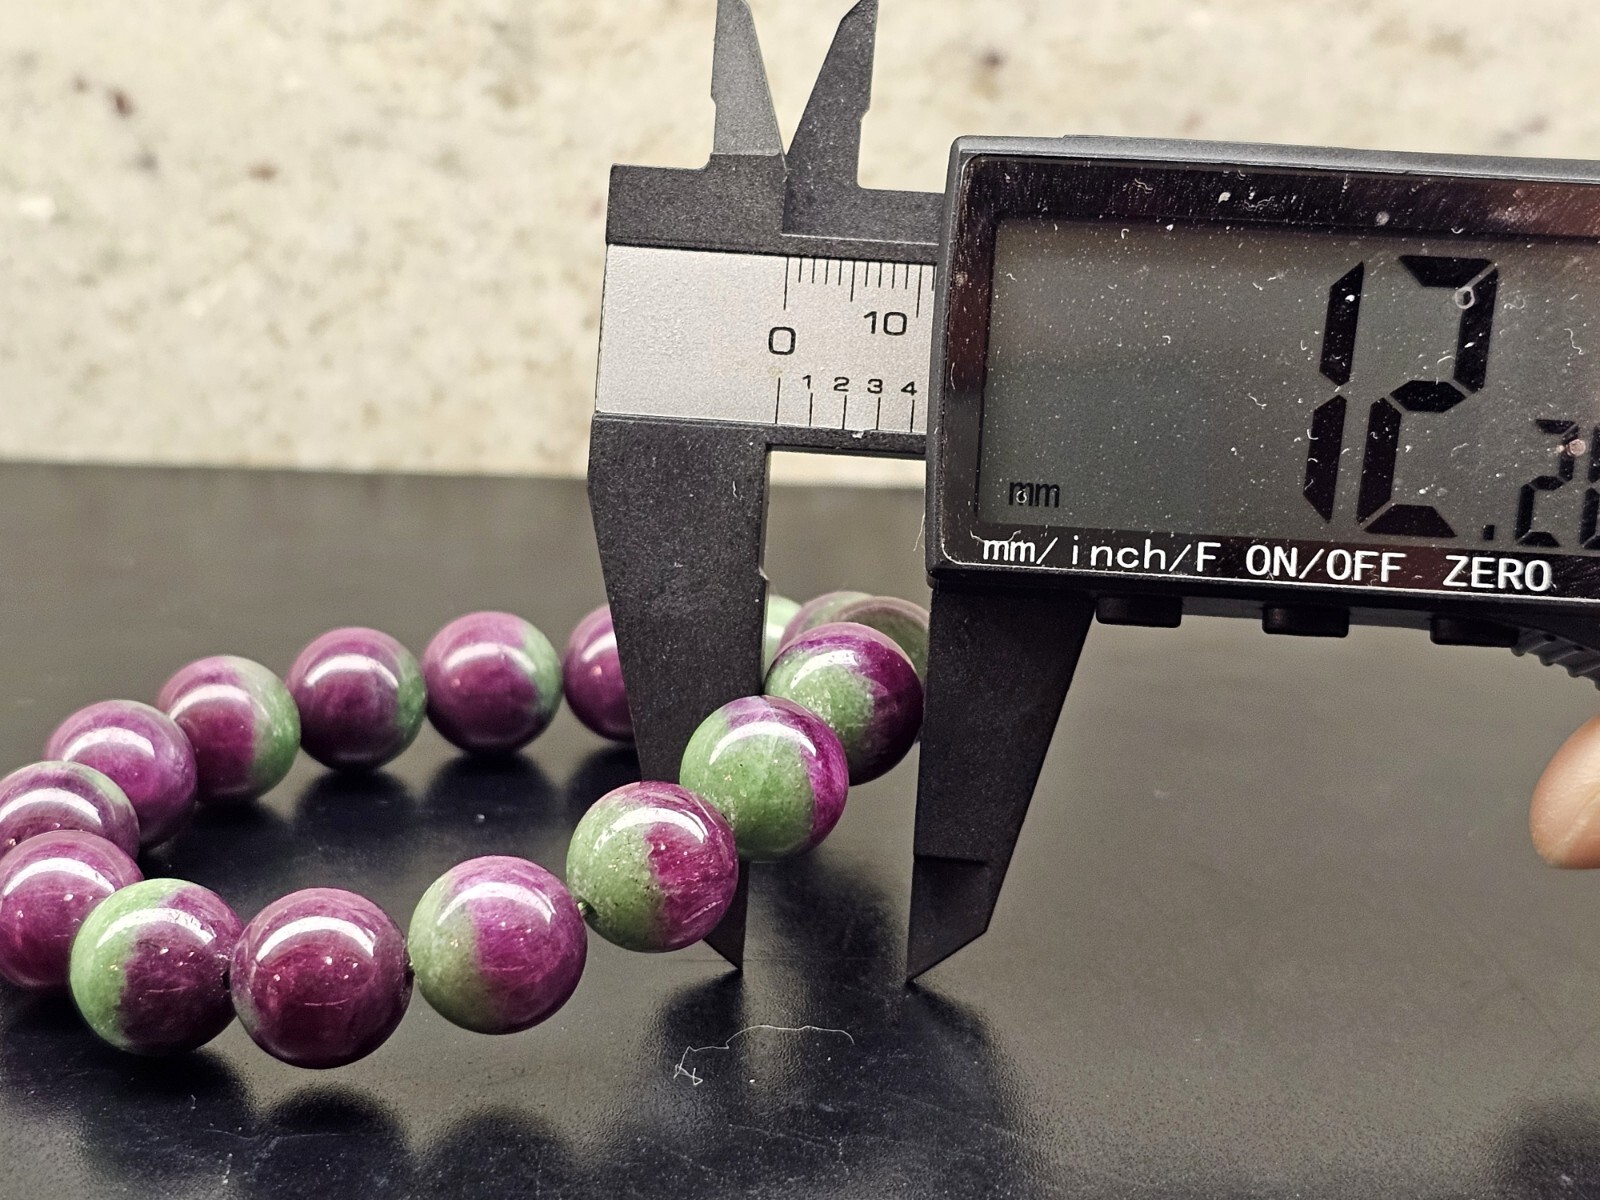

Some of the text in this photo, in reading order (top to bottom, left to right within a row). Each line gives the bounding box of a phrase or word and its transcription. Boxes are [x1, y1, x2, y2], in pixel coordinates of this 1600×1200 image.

[768, 311, 908, 355] 0 10
[802, 374, 917, 396] 1 2 3 4
[1008, 481, 1060, 508] mm
[1245, 544, 1407, 583] ON/OFF
[1442, 554, 1552, 592] ZERO
